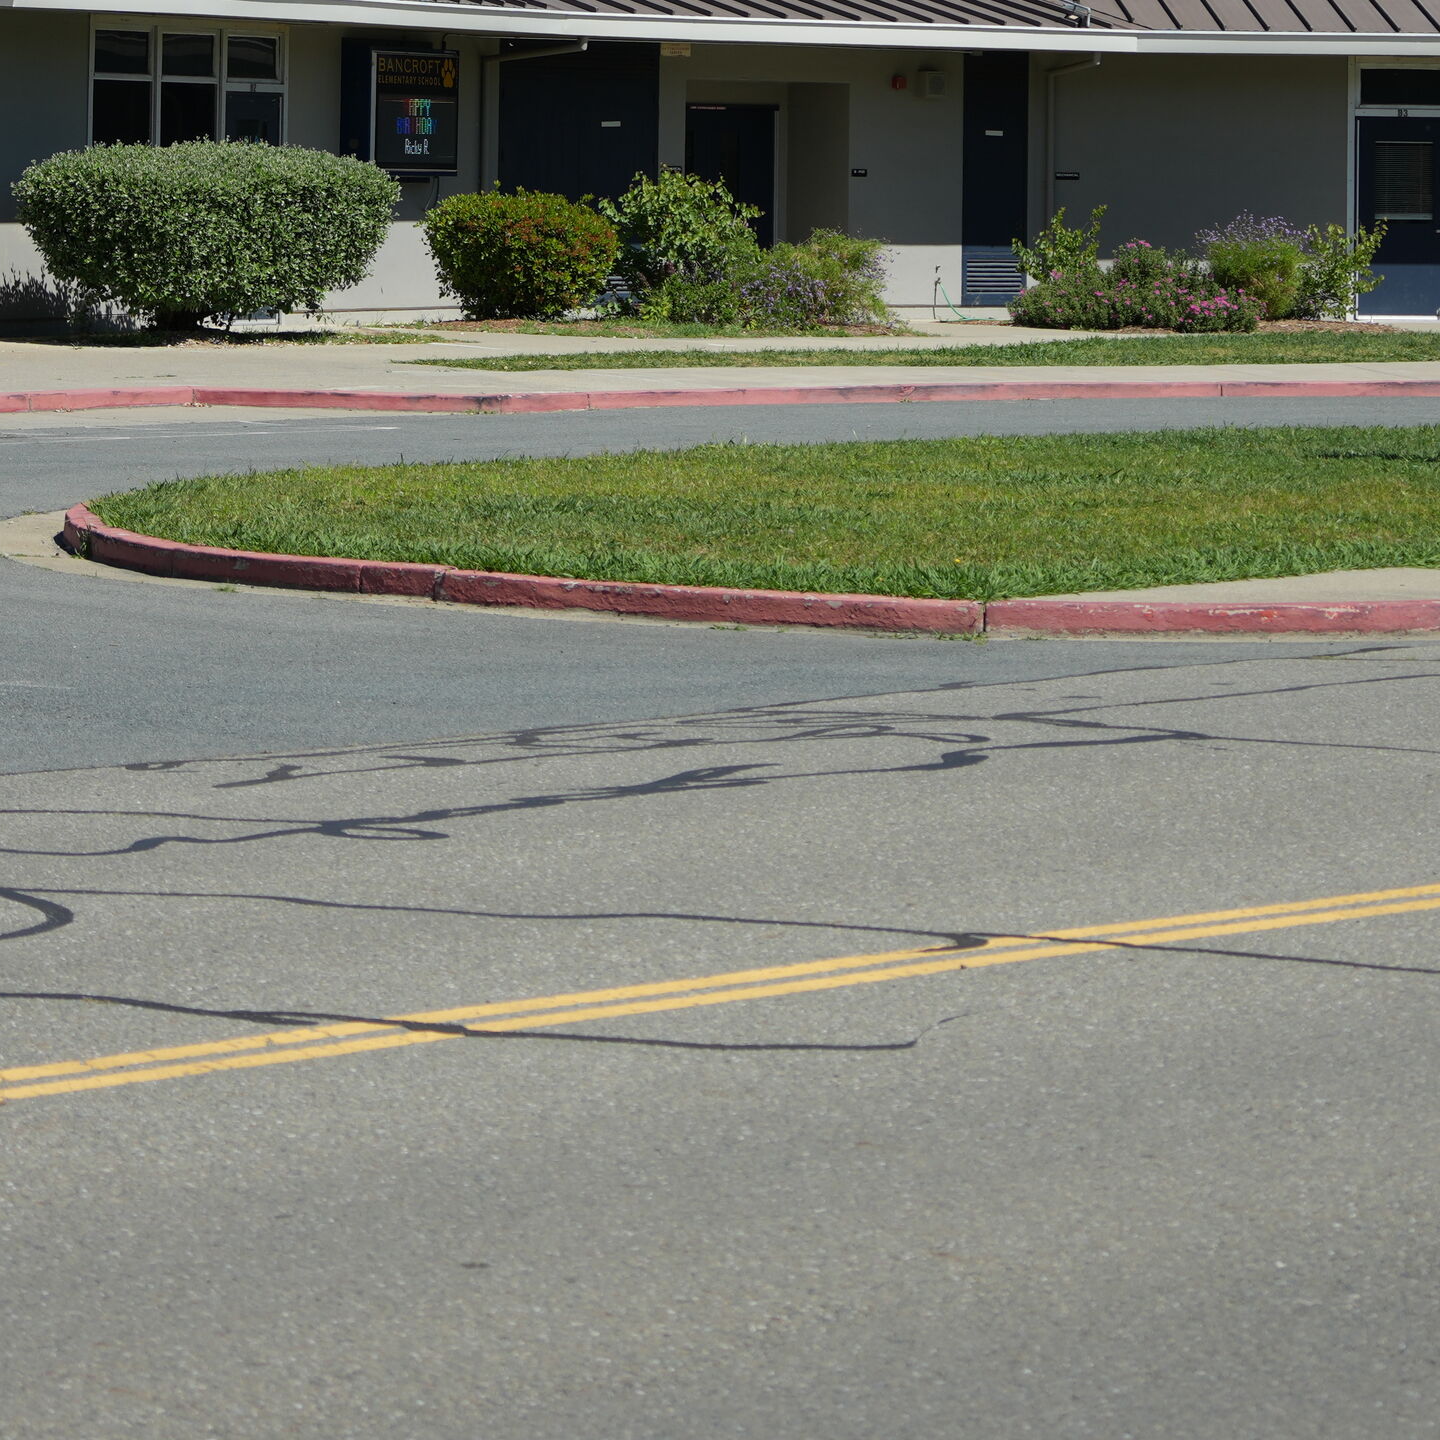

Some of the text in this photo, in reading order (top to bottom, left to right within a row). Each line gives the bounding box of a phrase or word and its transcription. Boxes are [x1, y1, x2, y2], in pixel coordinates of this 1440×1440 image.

[378, 58, 440, 74] BANCROFT
[378, 74, 441, 86] ELEMENTARY SCHOOL
